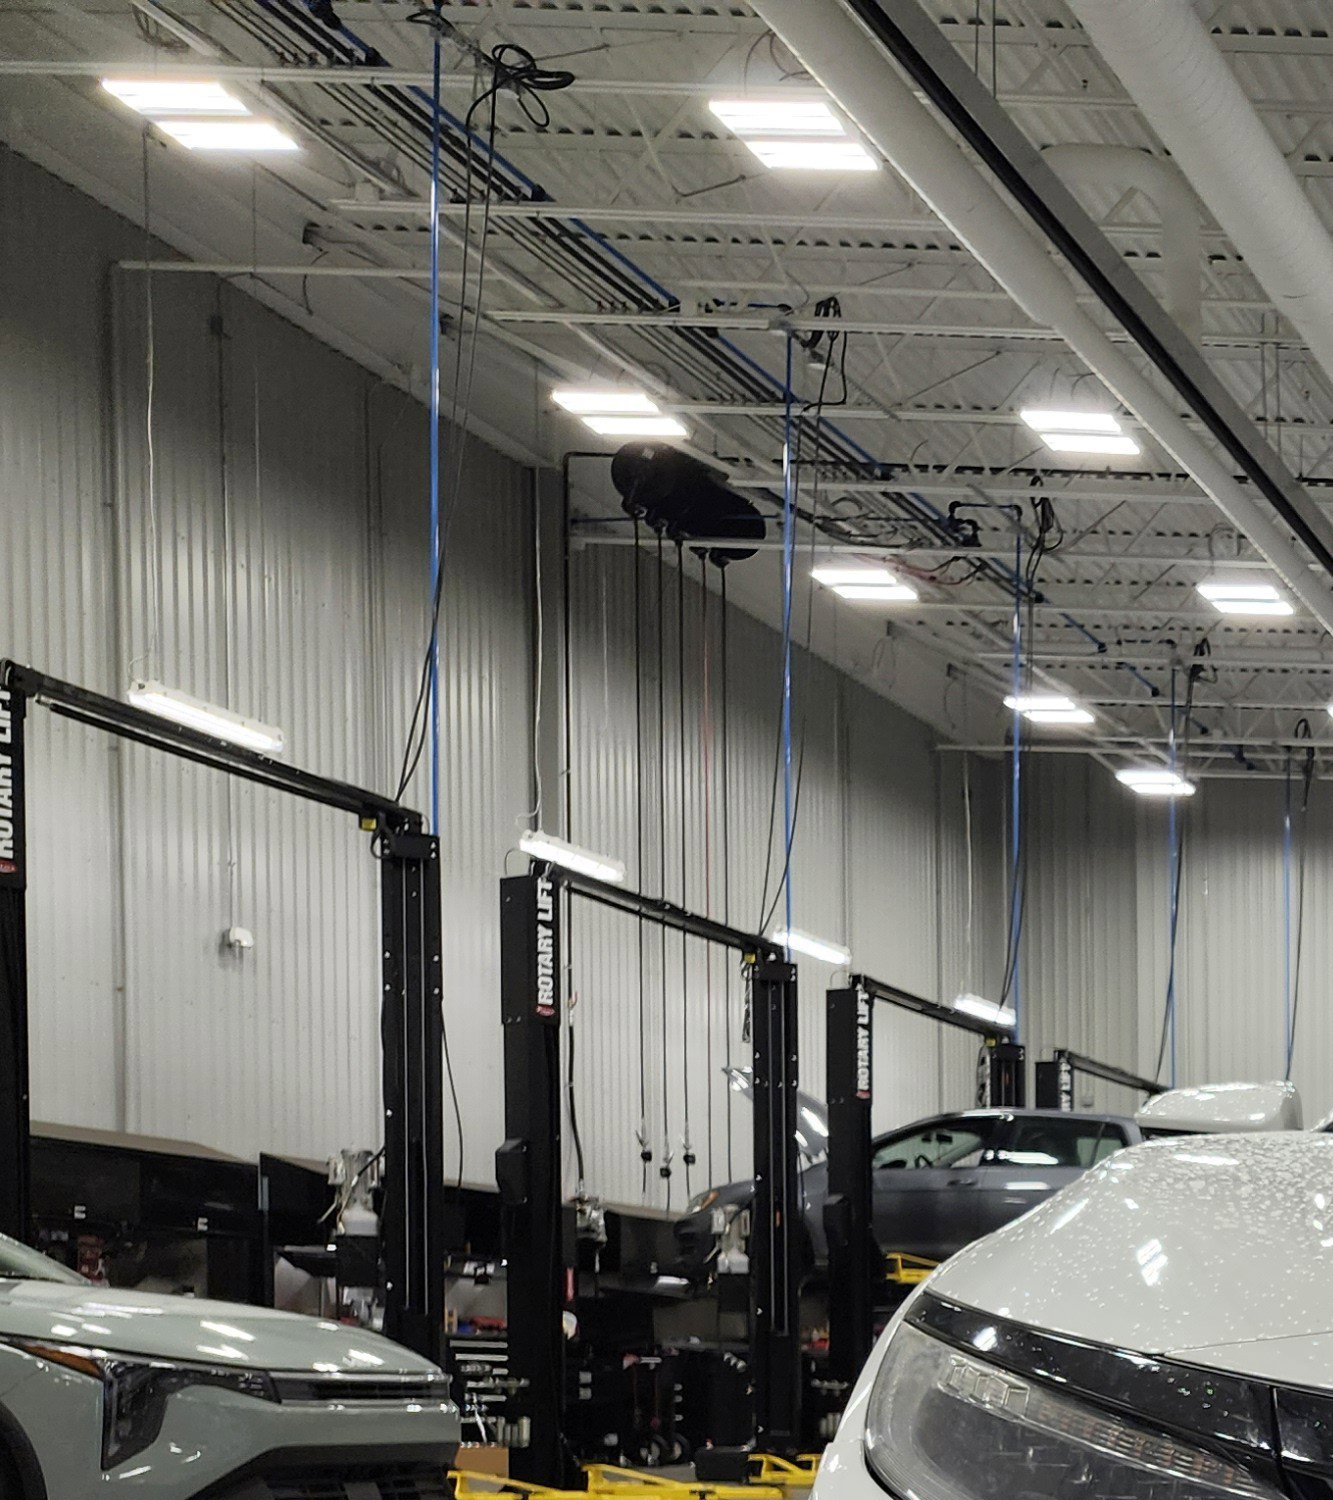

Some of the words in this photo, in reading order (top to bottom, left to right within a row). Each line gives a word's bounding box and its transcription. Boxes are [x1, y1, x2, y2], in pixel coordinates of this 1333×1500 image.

[537, 876, 554, 922] LIFT
[537, 922, 554, 1006] ROTARY
[856, 987, 869, 1025] LIFT
[856, 1025, 869, 1091] ROTARY
